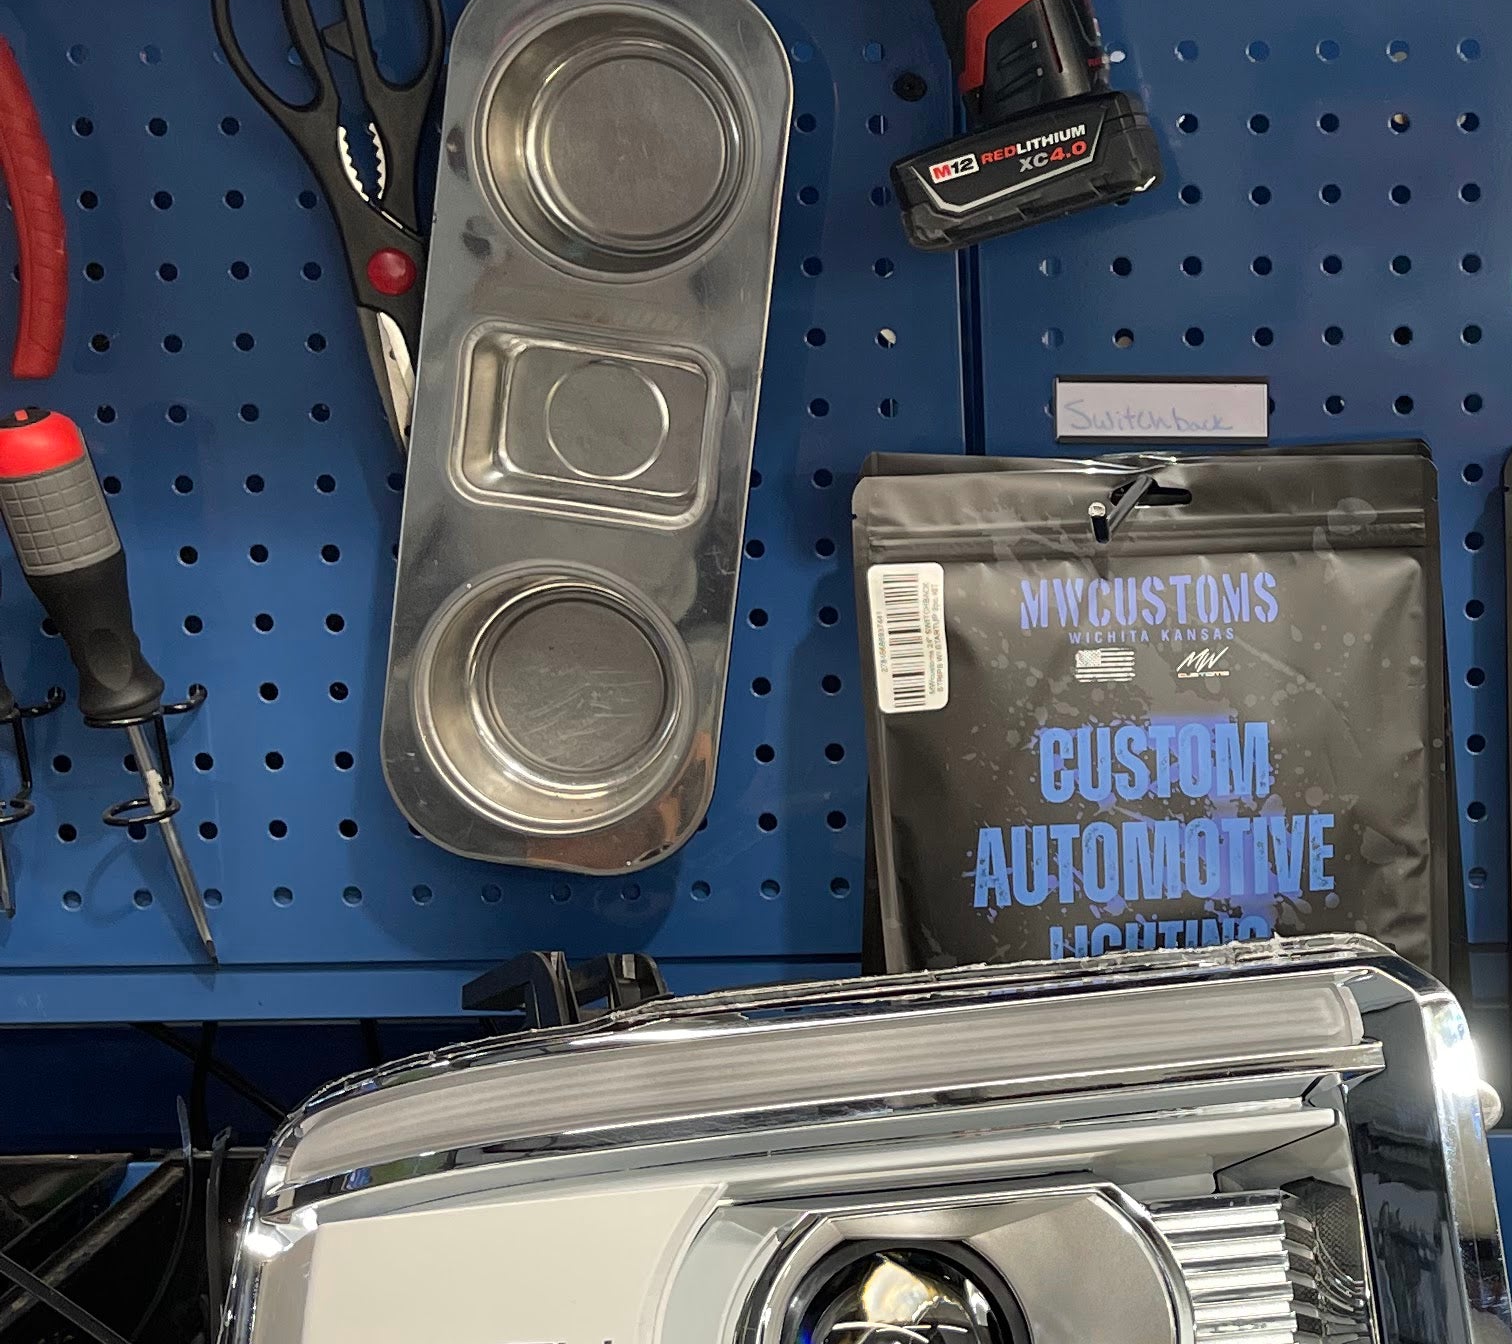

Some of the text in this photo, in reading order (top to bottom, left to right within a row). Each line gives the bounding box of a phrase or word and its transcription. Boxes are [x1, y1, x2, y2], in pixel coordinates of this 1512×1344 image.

[931, 123, 1087, 181] M12 REDLITHIUM
[1019, 140, 1088, 173] XC4.0
[1020, 571, 1280, 631] MWCUSTOMS
[1068, 627, 1235, 645] WICHITA KANSAS
[1039, 721, 1271, 804] CUSTOM
[973, 812, 1336, 909] AUTOMOTIVE
